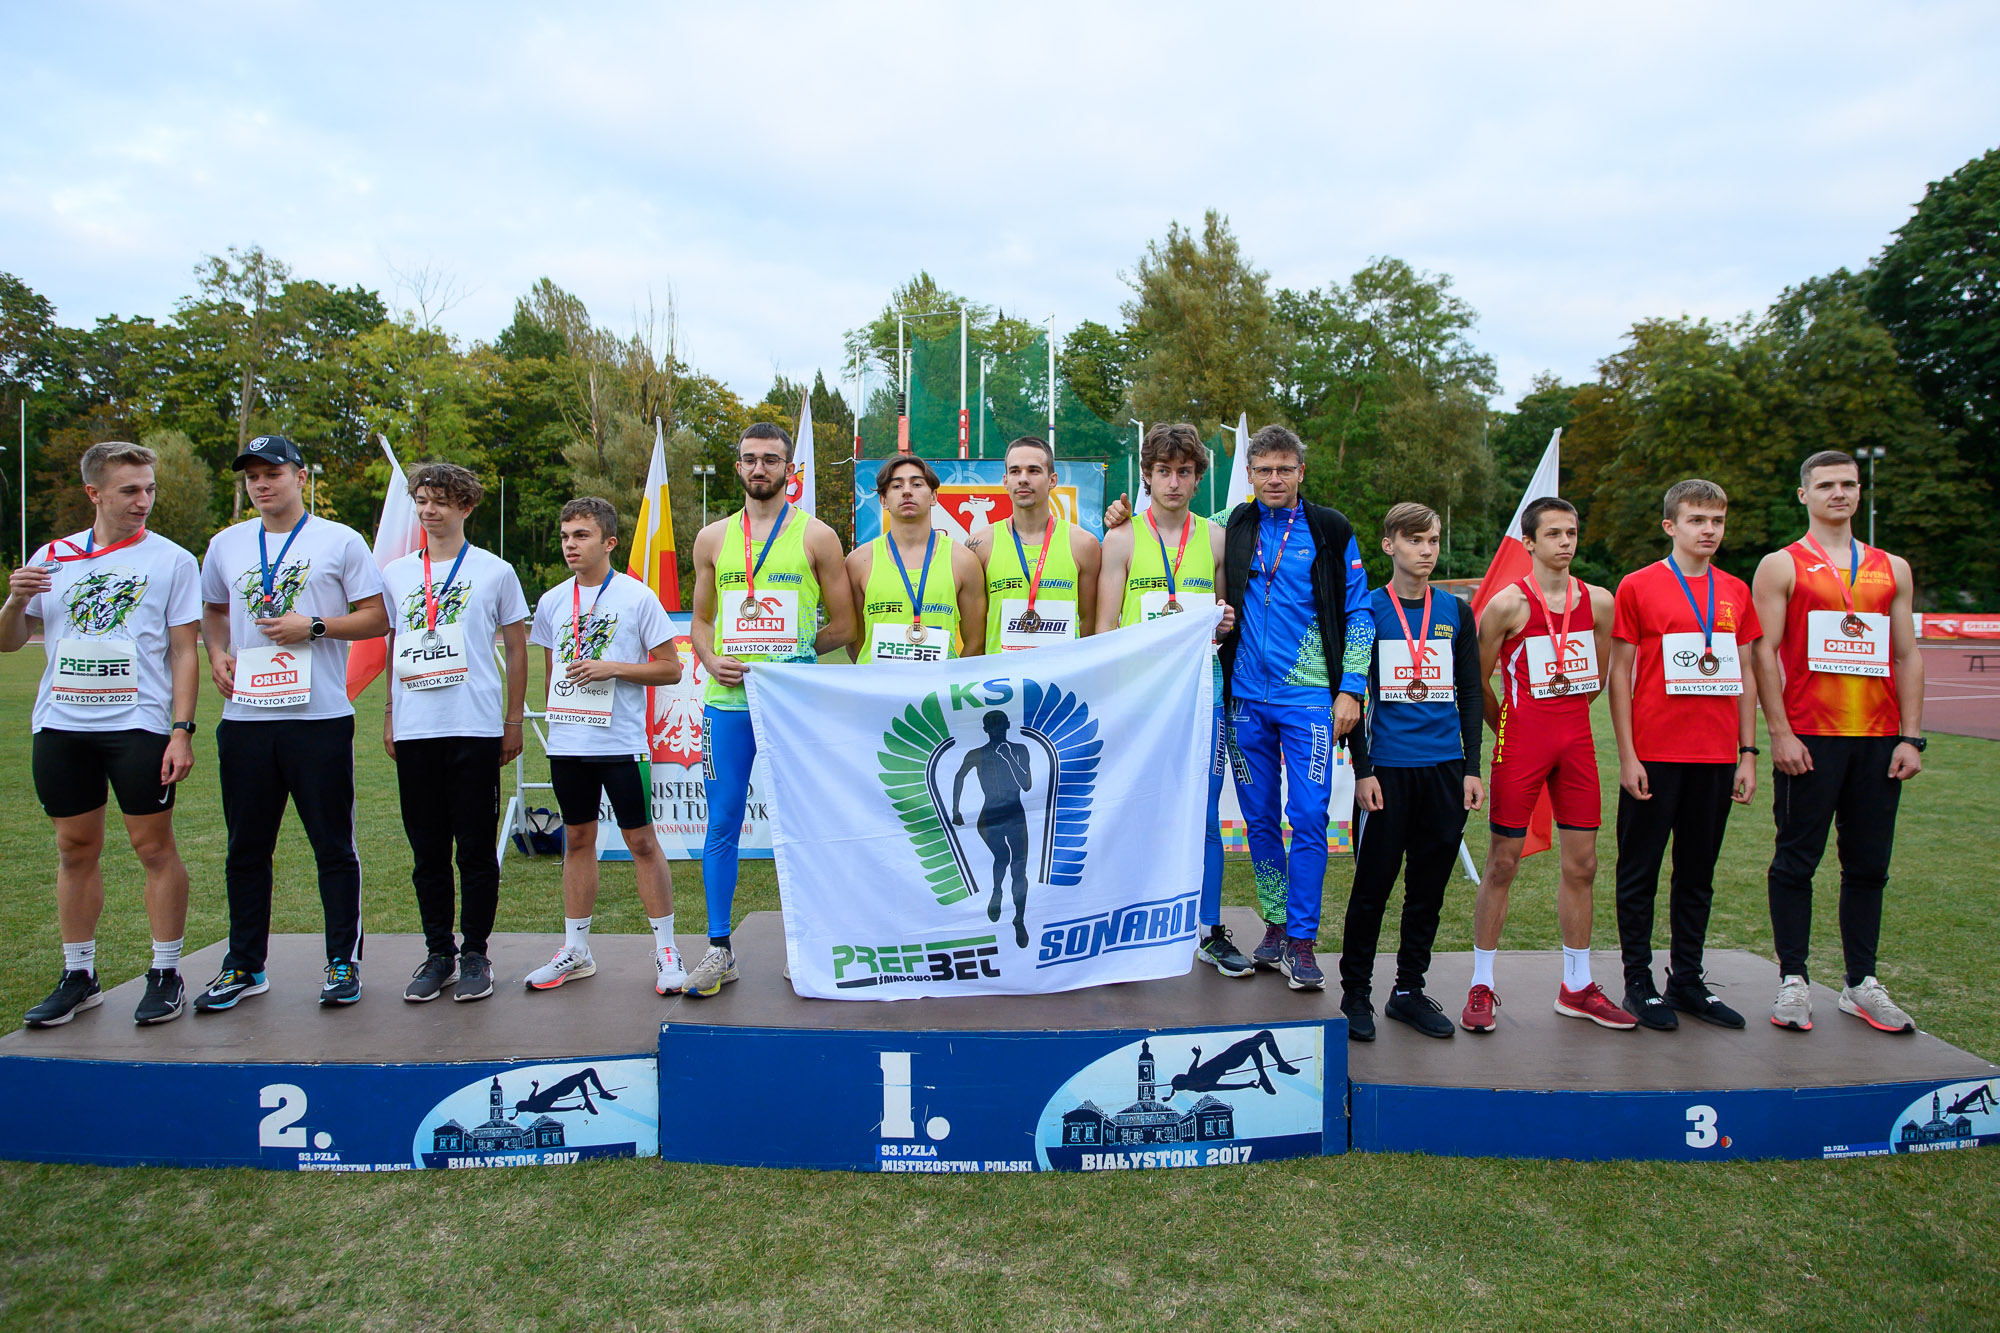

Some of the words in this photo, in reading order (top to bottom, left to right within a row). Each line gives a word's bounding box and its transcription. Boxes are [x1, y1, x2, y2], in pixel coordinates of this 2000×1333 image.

[739, 620, 782, 630] ORLEN
[400, 648, 413, 657] AF
[413, 645, 459, 663] FUEL
[1826, 641, 1872, 653] ORLEN
[60, 657, 130, 677] PREFBET
[1396, 667, 1438, 678] OREN
[1547, 659, 1586, 674] OLEN
[1814, 663, 1861, 673] BIAŁYSTOK
[253, 672, 295, 686] ORLEN
[406, 678, 441, 689] BIAŁYSTOK
[444, 674, 464, 683] 2022
[1581, 682, 1597, 690] 2022
[580, 686, 609, 696] Okęcie
[950, 678, 1014, 712] KS
[56, 694, 105, 703] BIAŁYSTOK
[237, 696, 285, 706] BIAŁYSTOK
[287, 695, 306, 704] 2022
[549, 713, 585, 723] BIAŁYSTOK
[587, 716, 607, 725] 2022
[1496, 703, 1508, 763] JUVENIA
[1309, 723, 1328, 784] SONAROL
[1039, 897, 1198, 962] SONAROL
[832, 935, 1001, 982] PREFBET
[878, 974, 932, 985] ŚNIADOWO
[880, 1052, 950, 1140] 1.
[260, 1083, 332, 1150] 2.
[1909, 1141, 1957, 1152] BIAŁYSTOK
[1960, 1138, 1980, 1148] 2017
[448, 1154, 537, 1169] BIAŁYSTOK
[543, 1152, 580, 1165] 2017
[1082, 1149, 1198, 1171] BIAŁYSTOK
[1207, 1146, 1253, 1165] 2017
[375, 1162, 411, 1171] POLSKI
[881, 1160, 980, 1172] MISTRZOSTWA
[984, 1161, 1032, 1172] POLSKI
